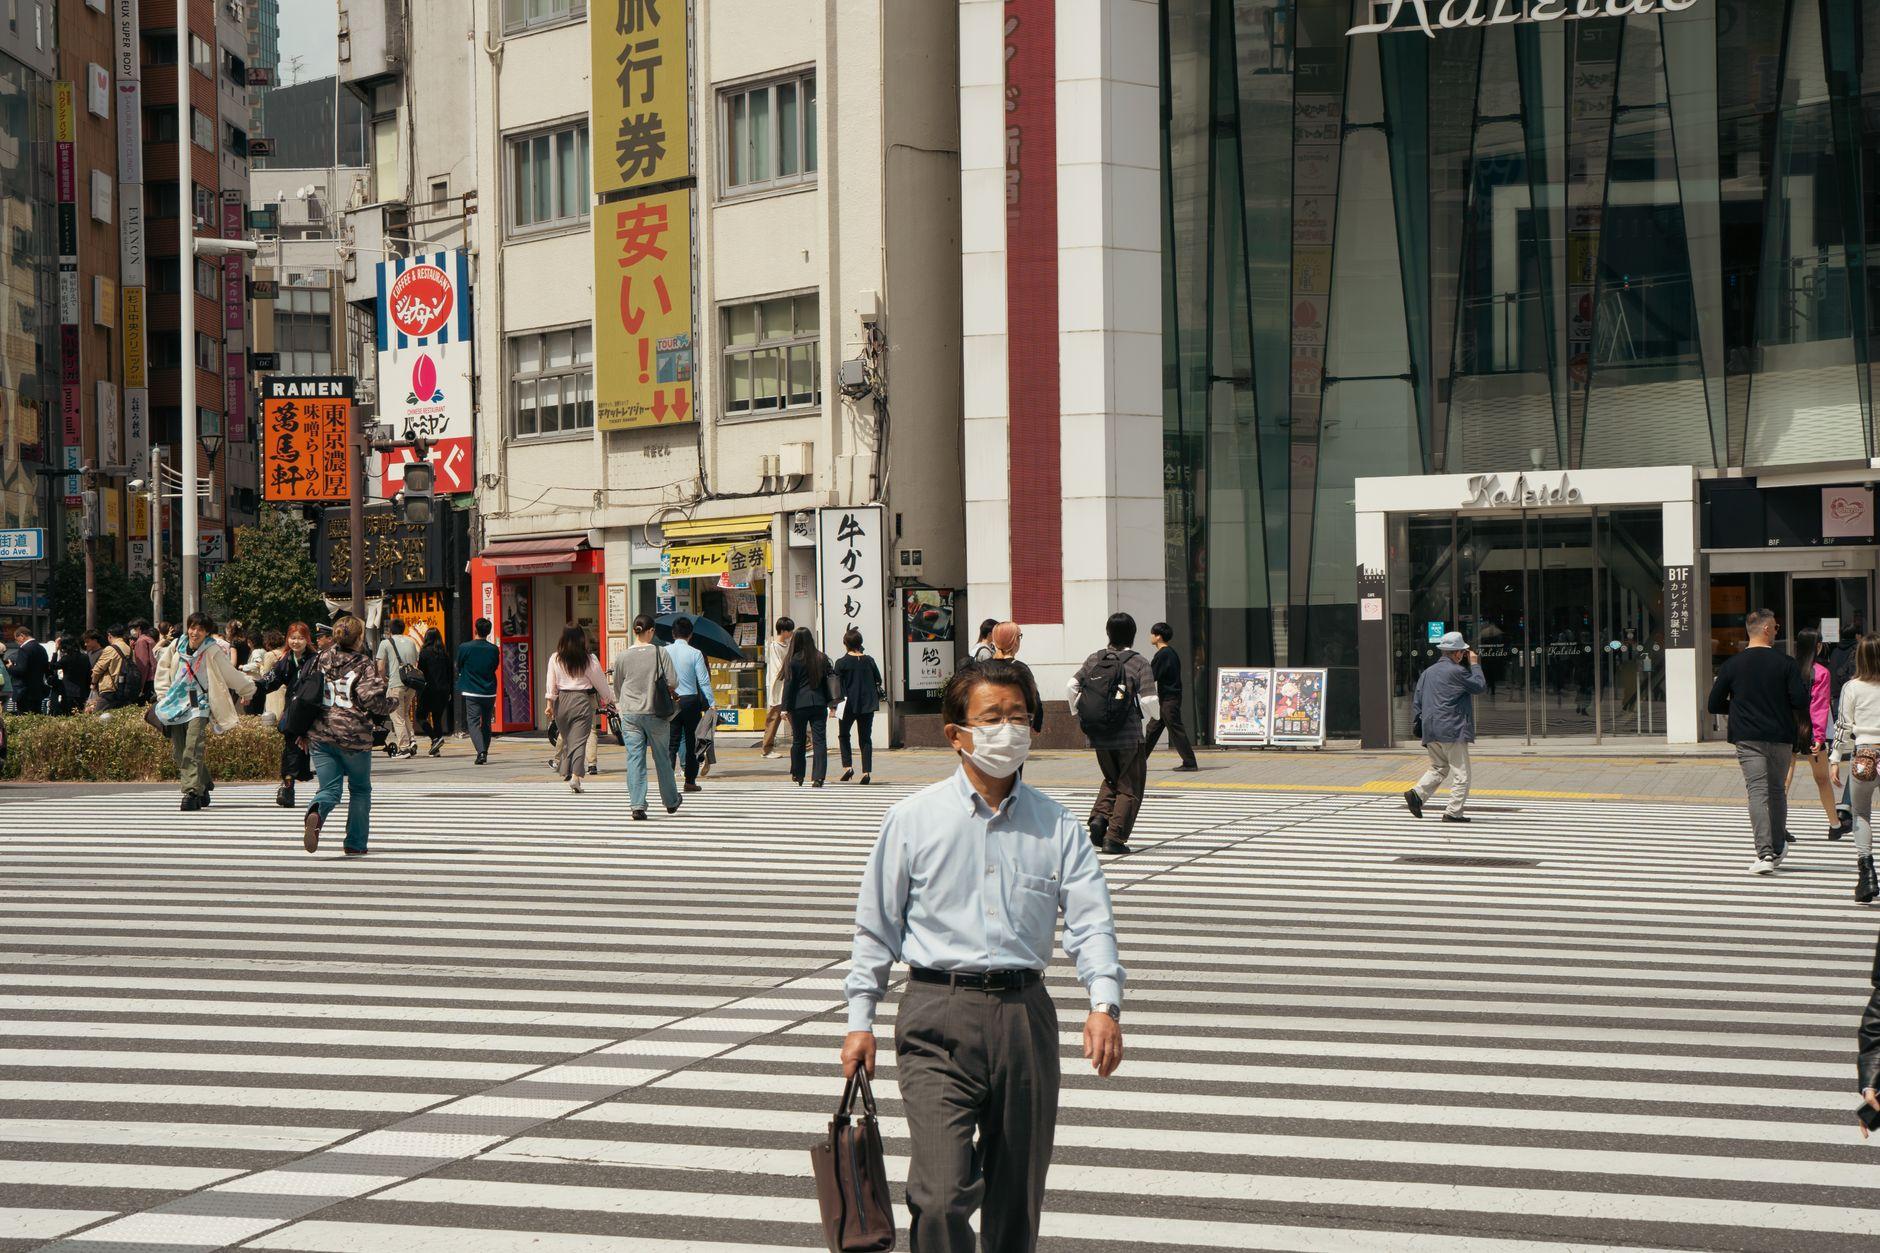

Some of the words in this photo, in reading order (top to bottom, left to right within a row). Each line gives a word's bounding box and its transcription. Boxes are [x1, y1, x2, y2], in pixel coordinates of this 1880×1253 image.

[122, 21, 131, 48] SUPER
[124, 52, 132, 77] BODY
[129, 207, 140, 264] EMANON
[229, 262, 241, 320] Reverse
[393, 273, 411, 299] COFFEE
[412, 270, 417, 281] &
[416, 268, 450, 292] RESTAURANT
[616, 203, 672, 384] 安い!
[658, 339, 678, 350] TOUR
[273, 382, 343, 396] RAMEN
[423, 406, 445, 414] RESTAURANT
[401, 413, 450, 437] バーミヤン
[303, 403, 320, 497] 味噌らーめん
[324, 405, 346, 496] 東京濃厚
[1461, 472, 1582, 507] Kaleido
[13, 548, 29, 556] Ave.
[731, 547, 764, 571] 金券
[1668, 568, 1688, 580] B1F
[391, 591, 445, 614] RAMEN
[1547, 647, 1581, 656] Kaleido
[518, 642, 529, 690] Device
